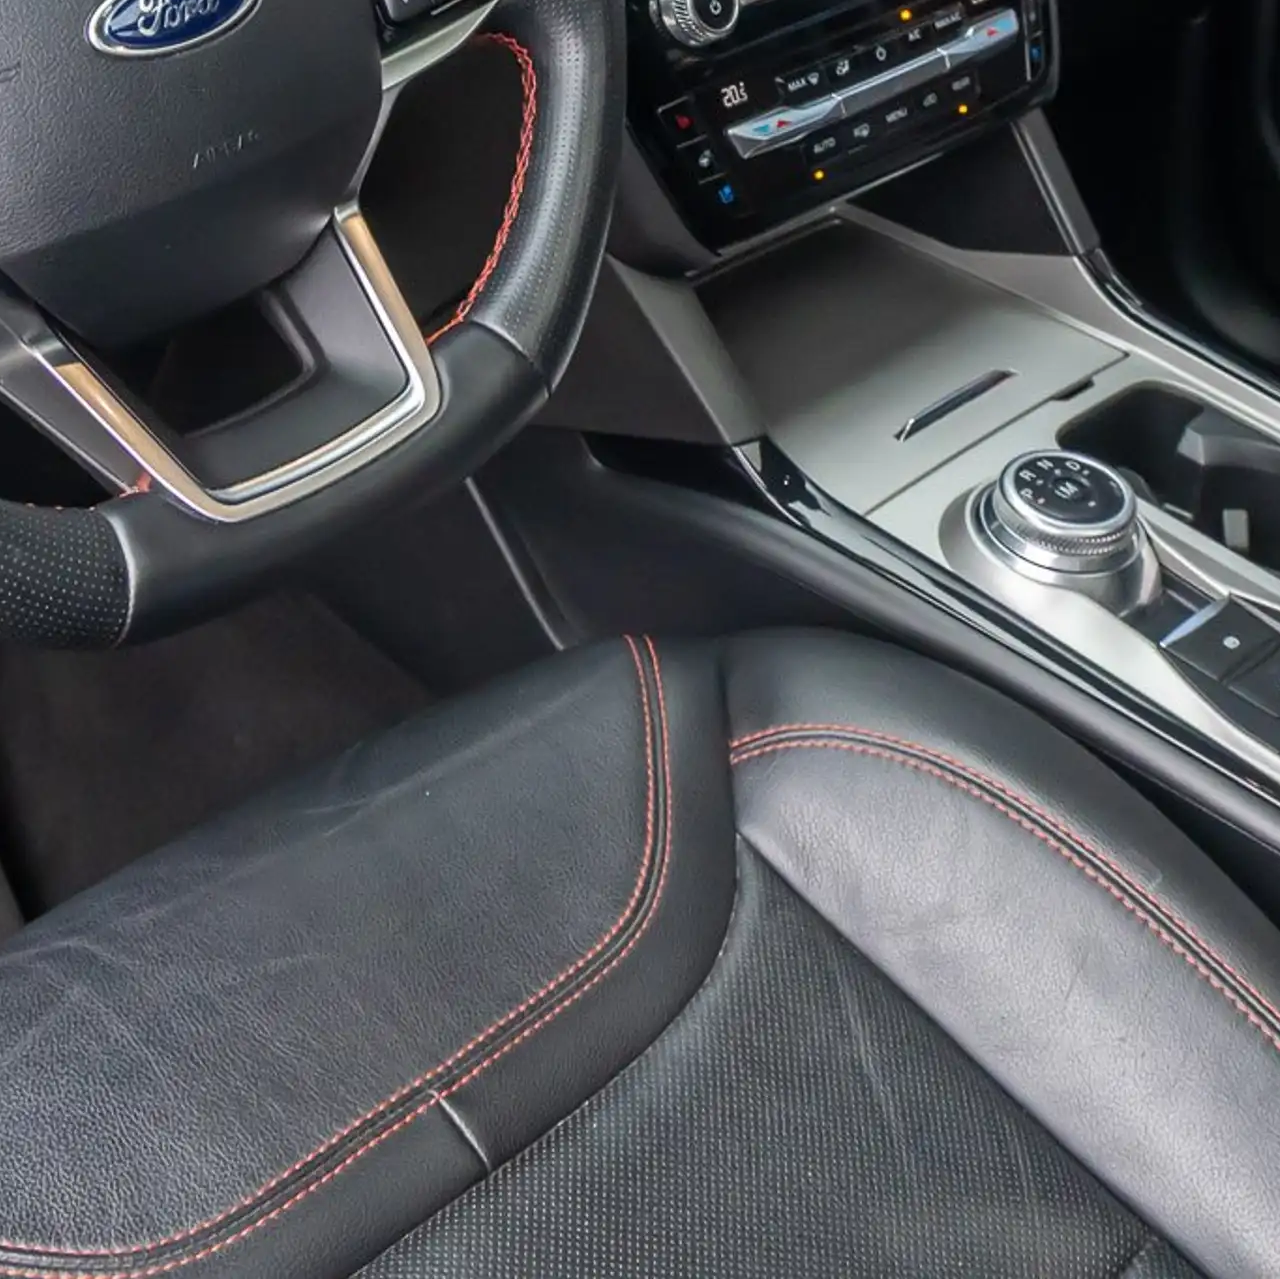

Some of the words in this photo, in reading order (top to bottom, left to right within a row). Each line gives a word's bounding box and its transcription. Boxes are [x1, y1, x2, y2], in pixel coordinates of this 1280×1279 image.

[788, 76, 808, 91] MAX
[1065, 460, 1081, 471] D
[1018, 469, 1037, 481] R
[1020, 488, 1033, 500] P
